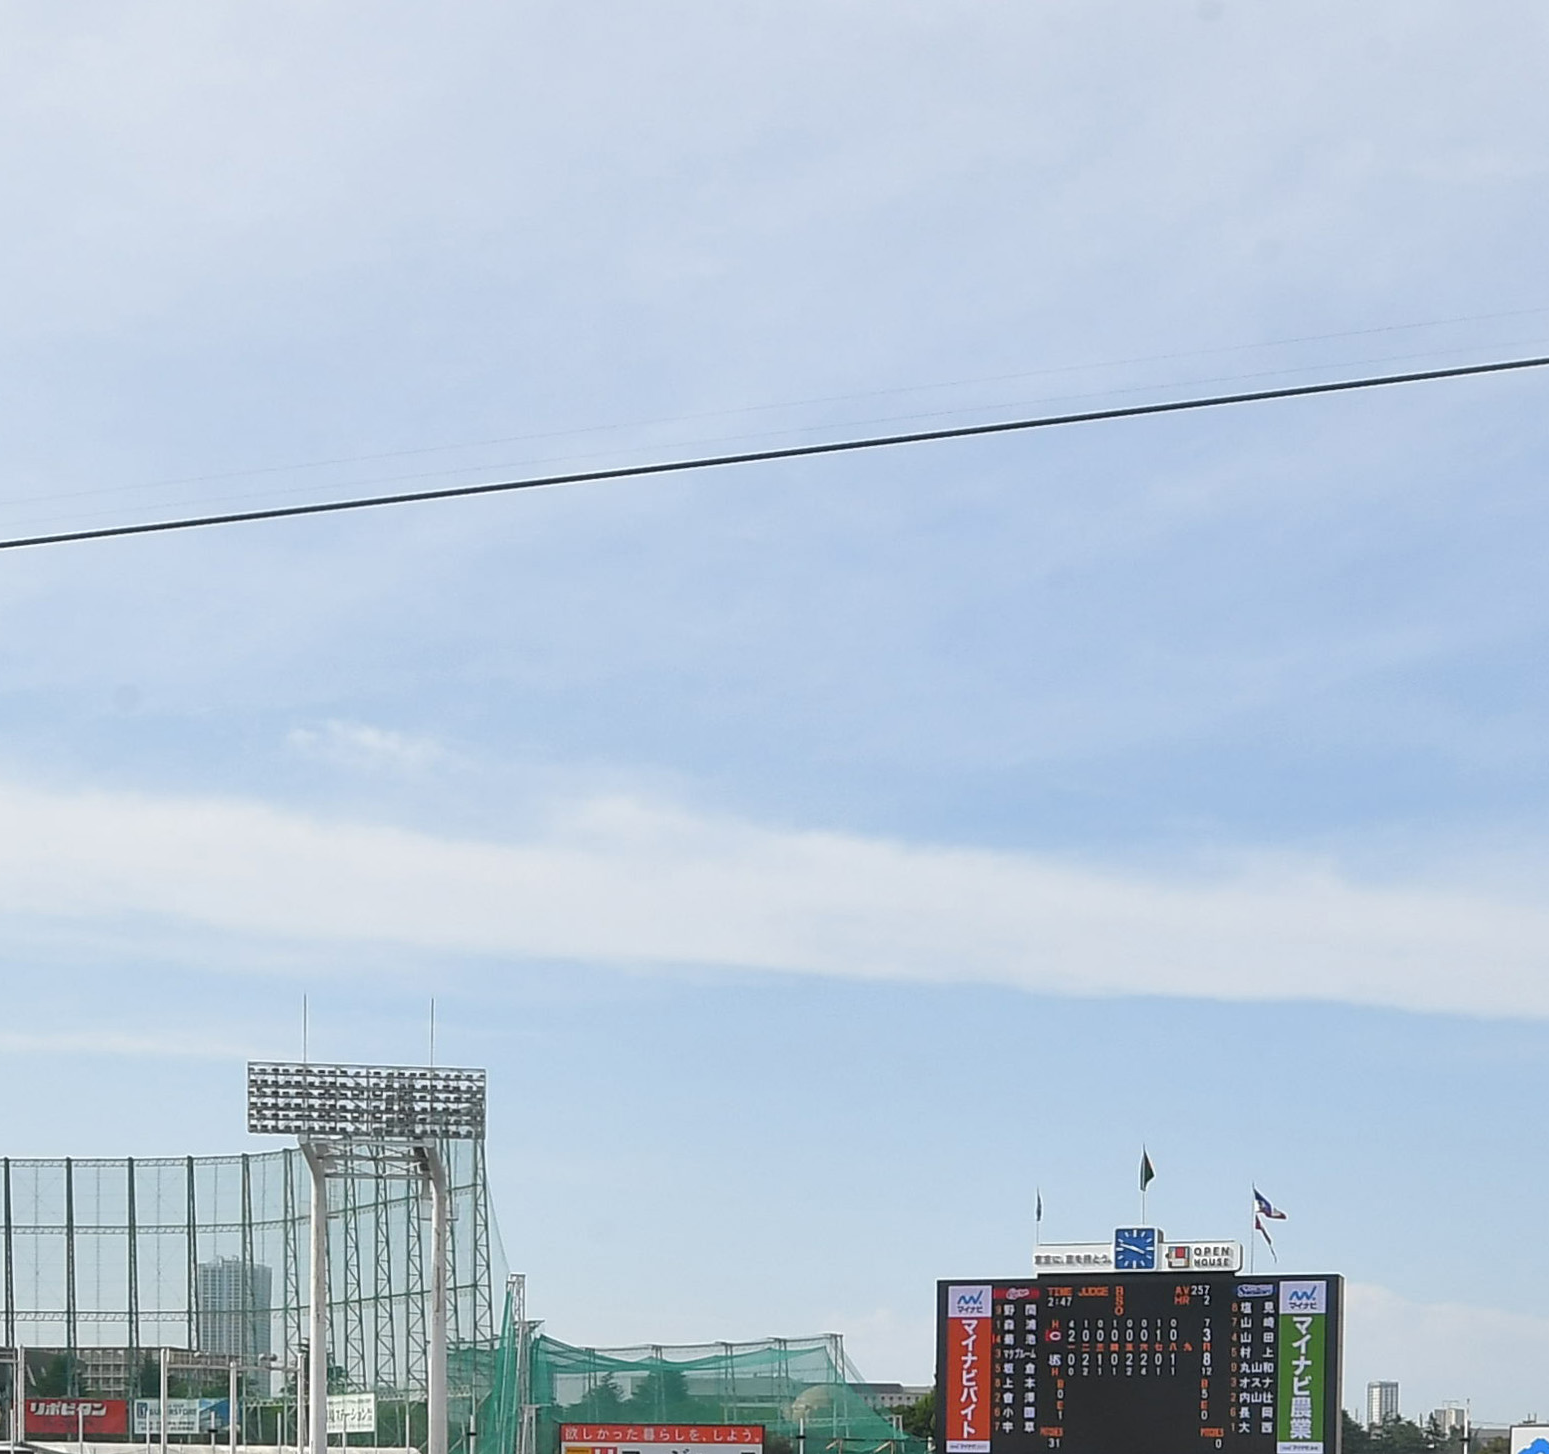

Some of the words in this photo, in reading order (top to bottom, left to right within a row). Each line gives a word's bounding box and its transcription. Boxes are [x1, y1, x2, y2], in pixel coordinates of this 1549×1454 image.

[1194, 1247, 1230, 1257] OPEN
[1194, 1258, 1229, 1267] HOUSE
[1078, 1286, 1109, 1297] JUDGE
[1191, 1285, 1211, 1295] 257
[1047, 1297, 1072, 1307] 2:47
[1288, 1302, 1318, 1310] マイナビ
[957, 1305, 983, 1314] マイナビ
[1239, 1362, 1274, 1374] 丸山和
[959, 1319, 979, 1439] マイナビバイト
[1239, 1377, 1274, 1388] オスナ
[1289, 1316, 1313, 1440] マイナビ農業
[30, 1402, 107, 1416] リポビタン
[565, 1427, 761, 1442] 欲しかった暮らしを、しよう。
[1048, 1438, 1060, 1448] 31
